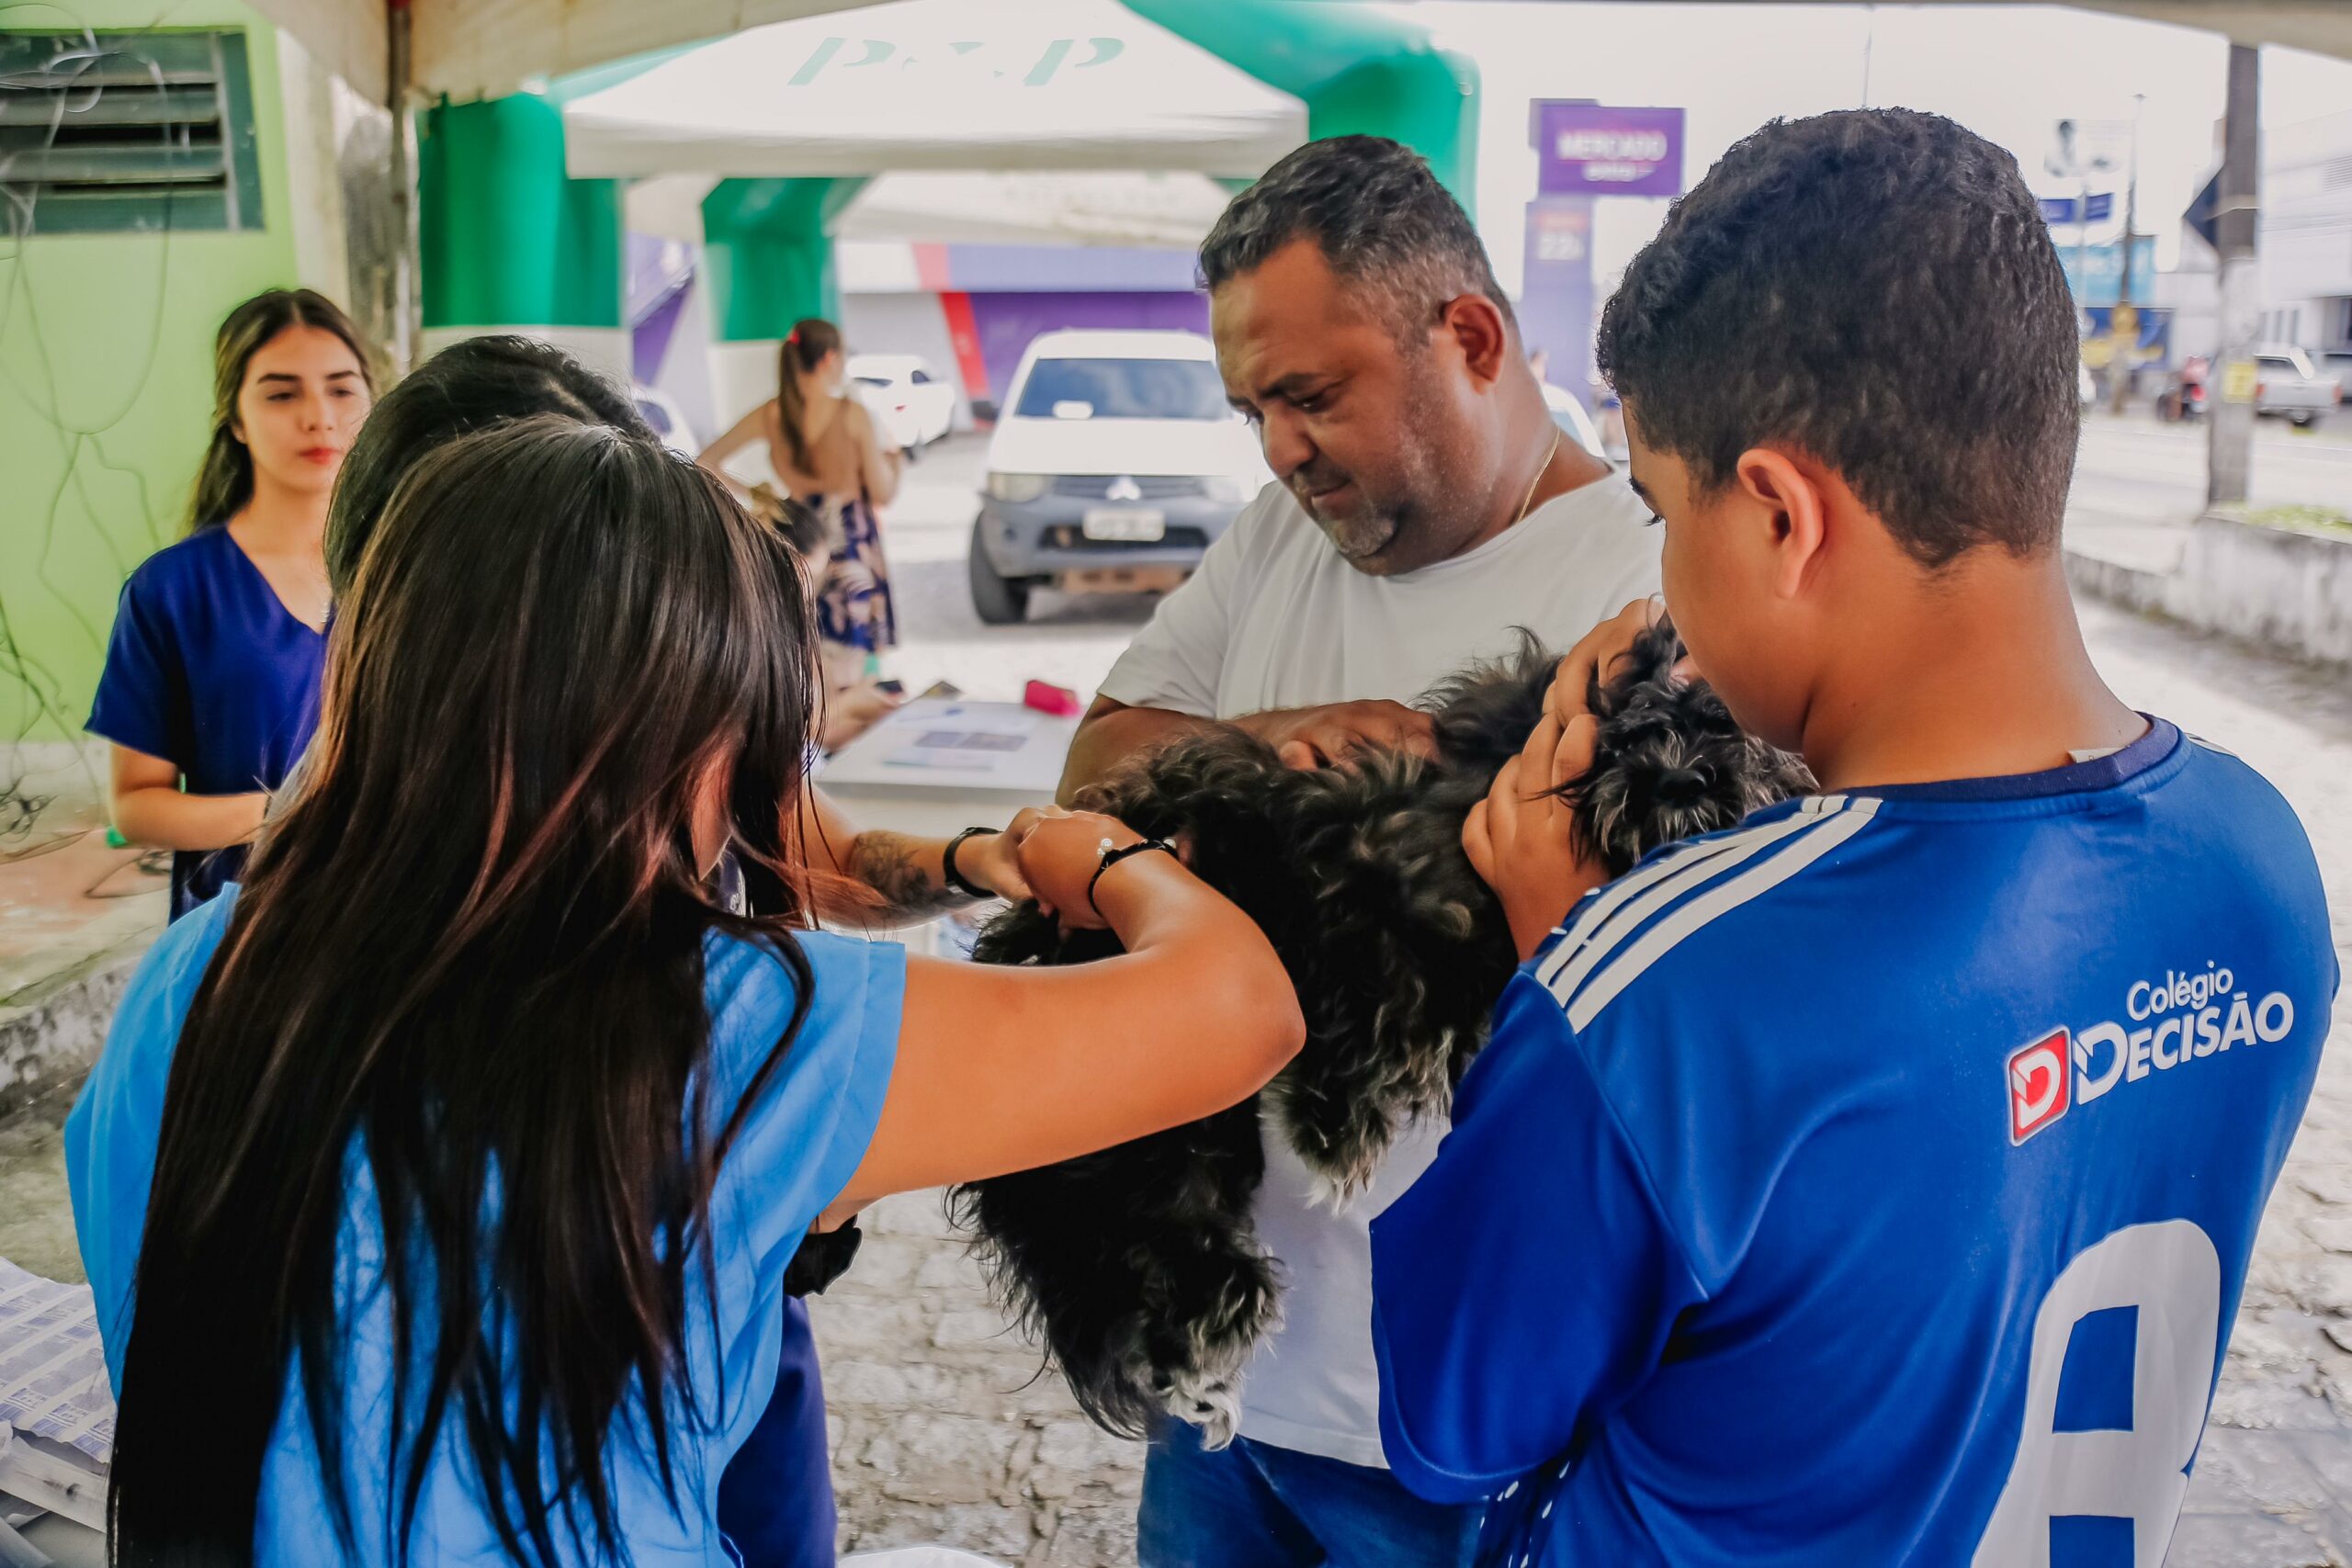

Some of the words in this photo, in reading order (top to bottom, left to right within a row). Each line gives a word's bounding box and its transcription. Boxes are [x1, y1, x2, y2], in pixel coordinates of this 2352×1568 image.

[1556, 129, 1668, 162] MERCADO
[2127, 960, 2233, 1021] Colégio
[2074, 991, 2295, 1106] DECISÃO
